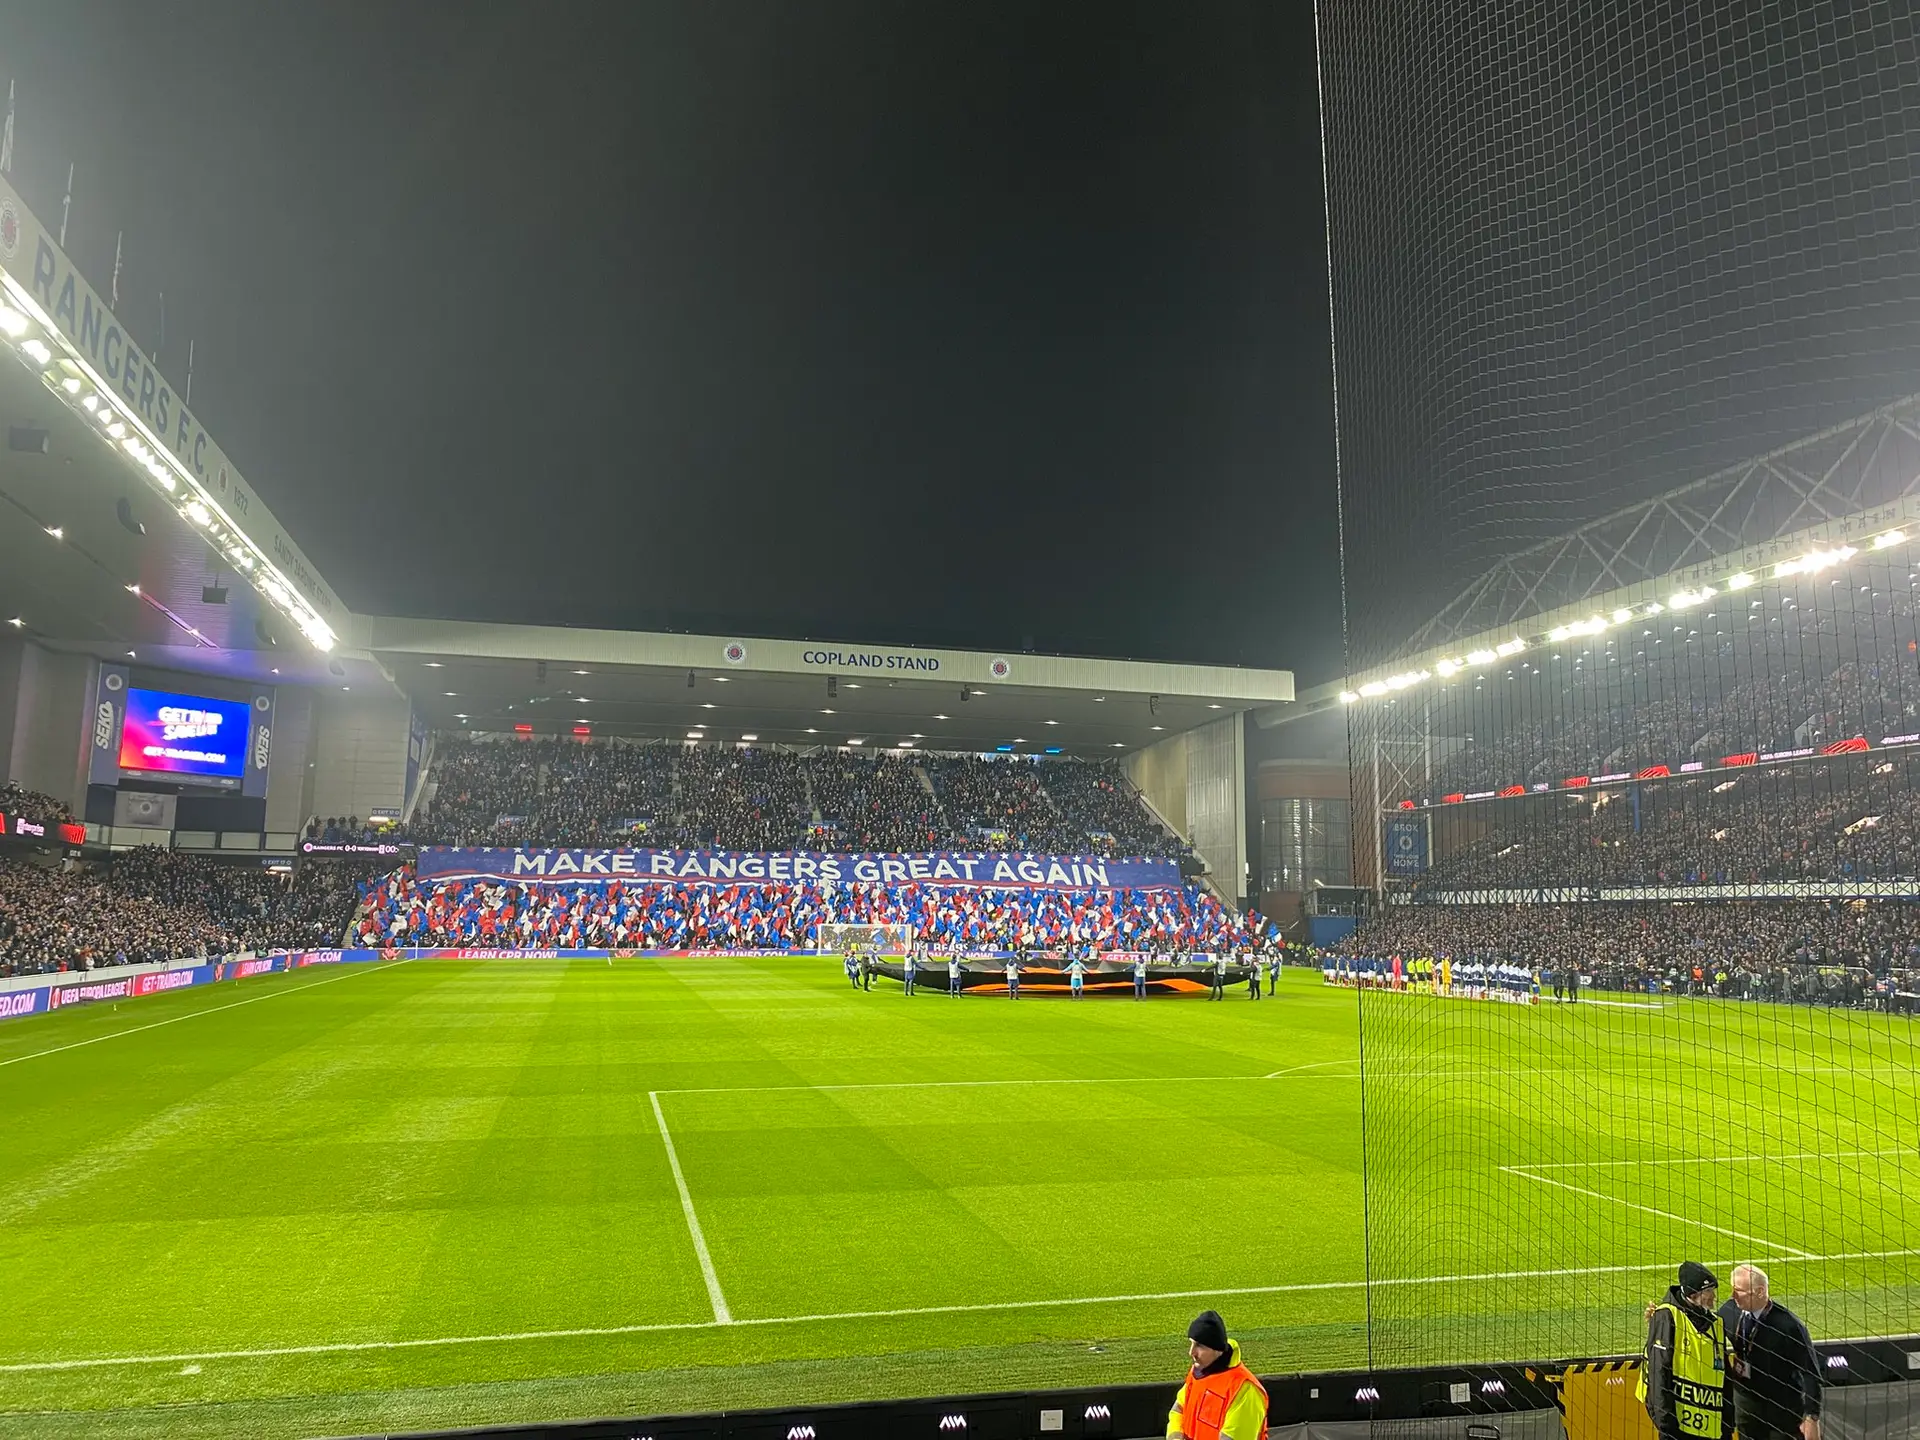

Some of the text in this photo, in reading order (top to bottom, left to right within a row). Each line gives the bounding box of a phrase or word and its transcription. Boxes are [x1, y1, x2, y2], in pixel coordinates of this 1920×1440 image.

[33, 234, 210, 483] RANGERS F.C.
[803, 651, 939, 671] COPLAND STAND
[95, 701, 114, 749] SEKO
[255, 725, 270, 770] SEKO
[513, 853, 1109, 887] MAKE RANGERS GREAT AGAIN
[458, 951, 558, 959] LEARN CPR NOW!
[61, 983, 80, 1005] UEFA
[104, 978, 126, 998] LEAGUE
[1672, 1379, 1724, 1407] TEWAR
[1680, 1410, 1710, 1431] 281
